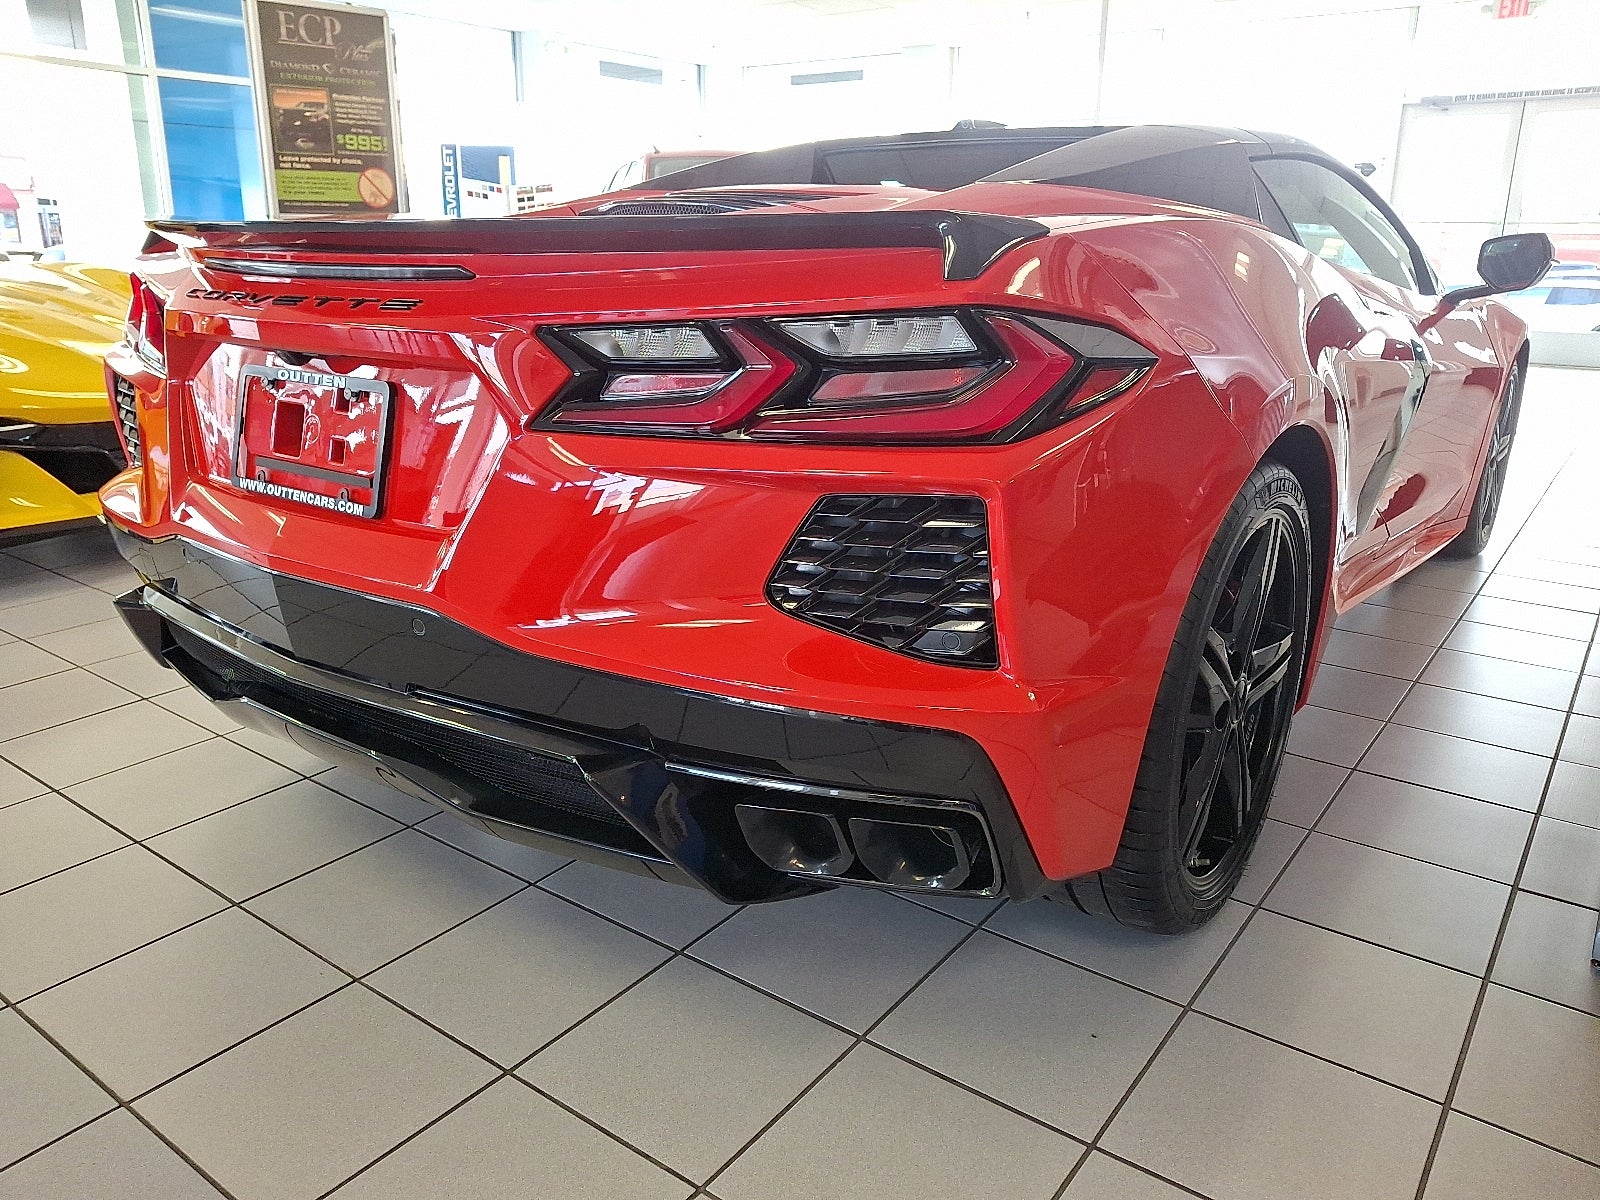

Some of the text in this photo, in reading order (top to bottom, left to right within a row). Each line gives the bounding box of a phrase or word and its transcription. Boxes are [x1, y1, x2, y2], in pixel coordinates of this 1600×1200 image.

[276, 10, 342, 46] ECP
[300, 155, 332, 164] protected
[186, 288, 424, 311] CORVETTE
[277, 369, 347, 389] OUTTEN
[239, 476, 365, 517] WWW.OUTTENCARS.COM
